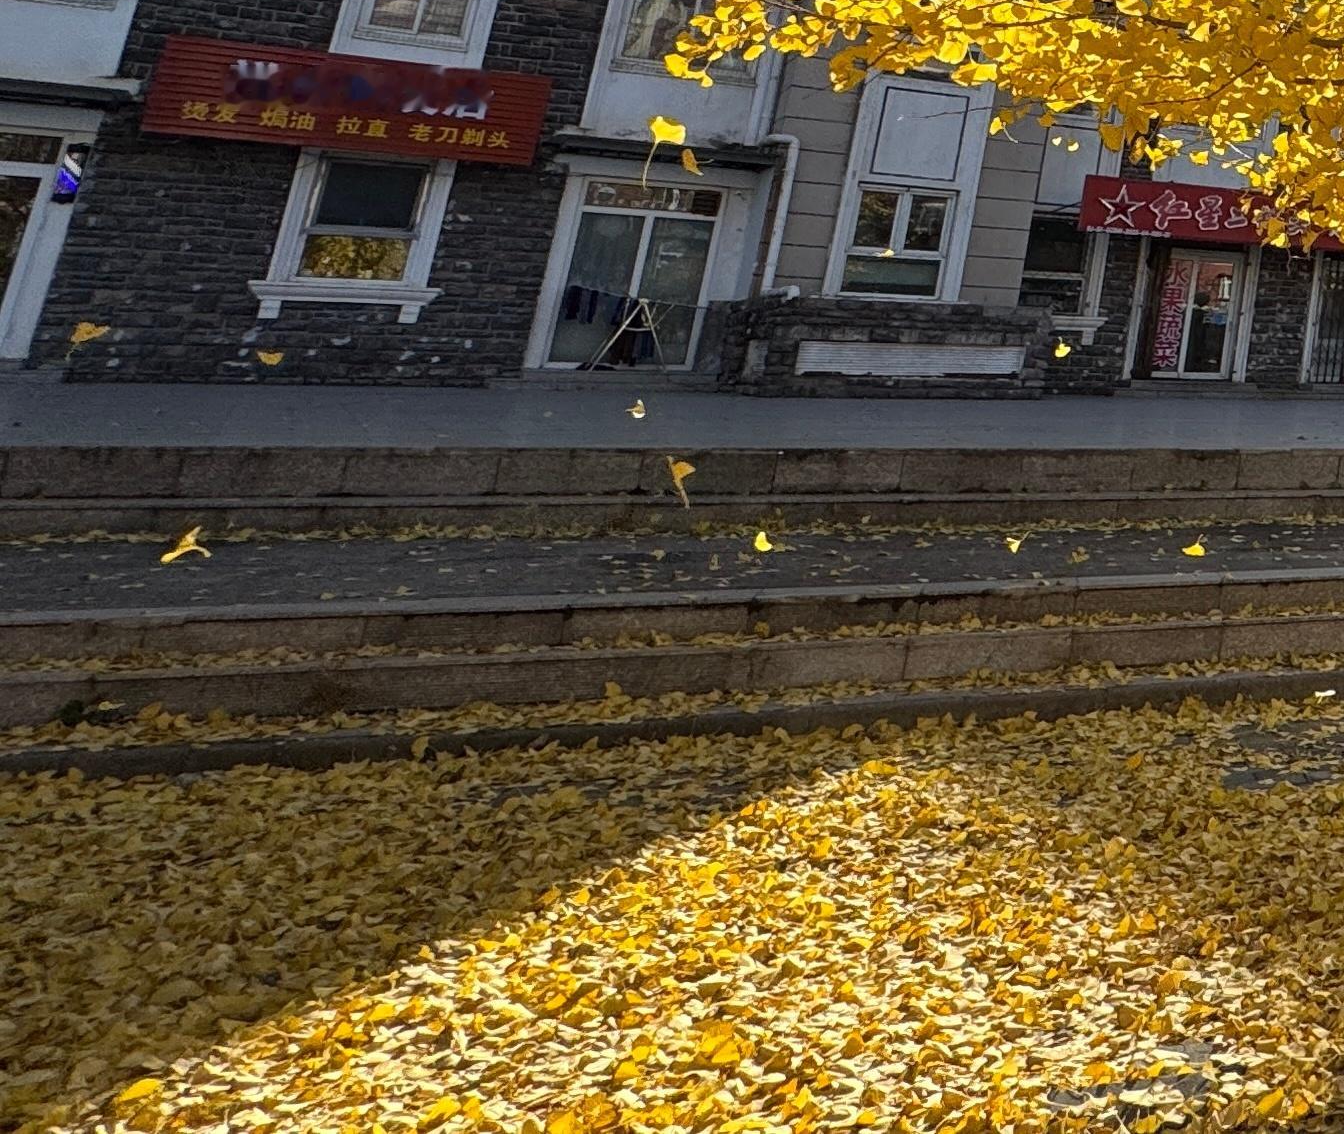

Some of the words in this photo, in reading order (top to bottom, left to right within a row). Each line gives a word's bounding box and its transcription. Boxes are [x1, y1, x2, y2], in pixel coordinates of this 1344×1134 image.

[336, 116, 391, 138] 拉直
[408, 123, 511, 148] 老刀剃头
[1152, 262, 1188, 366] 水果蔬菜
